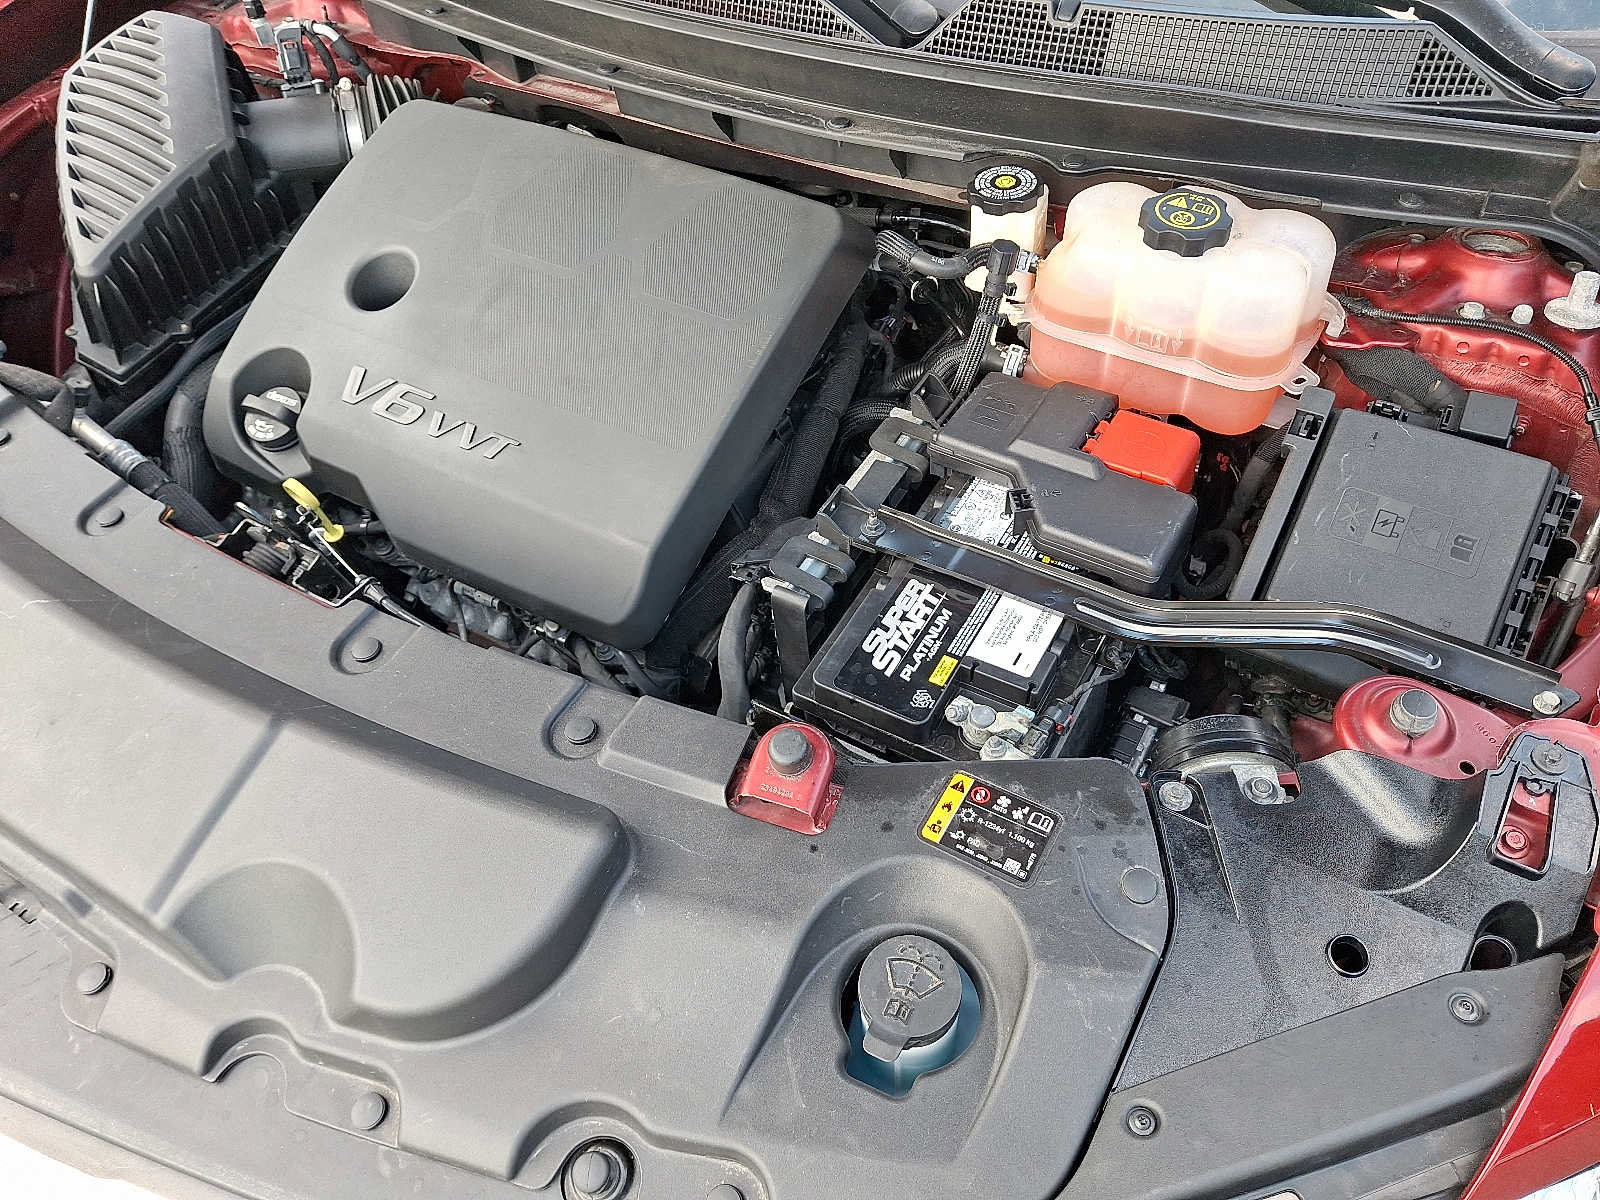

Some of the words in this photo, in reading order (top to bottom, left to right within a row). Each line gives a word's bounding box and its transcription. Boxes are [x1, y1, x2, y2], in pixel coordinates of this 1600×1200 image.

[342, 364, 437, 426] V6
[427, 410, 522, 460] VVT
[861, 578, 927, 653] SUPER
[872, 583, 940, 678] START
[899, 607, 953, 682] PLATINUM
[977, 817, 1007, 834] R-1234yf
[1025, 838, 1036, 849] kg
[992, 803, 1008, 814] AUTO
